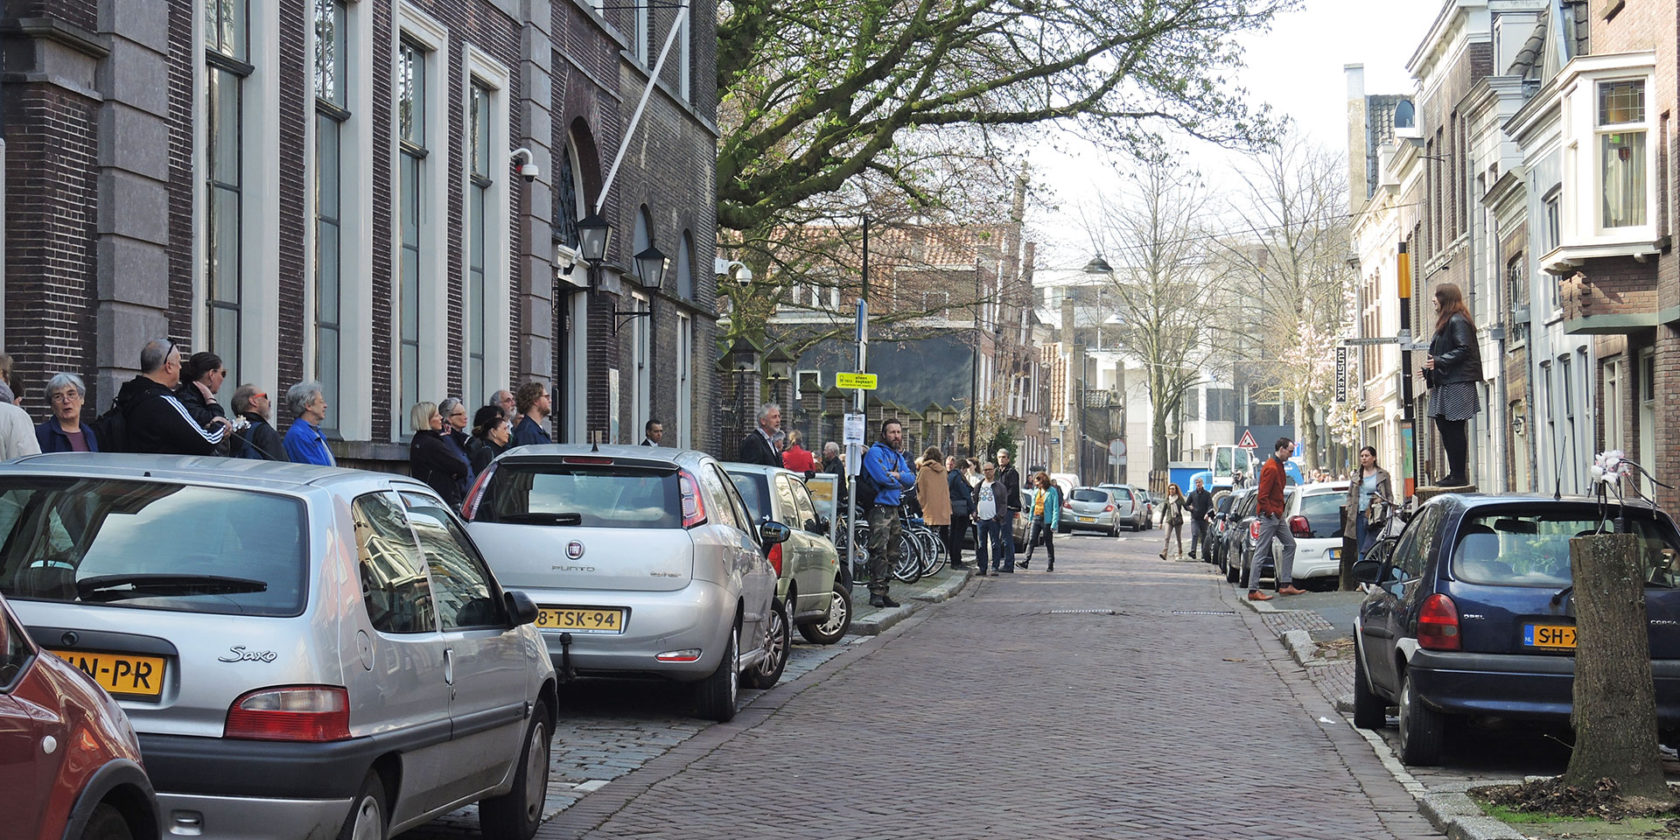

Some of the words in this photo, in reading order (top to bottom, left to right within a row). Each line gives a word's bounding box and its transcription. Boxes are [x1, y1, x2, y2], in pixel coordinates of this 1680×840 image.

[1337, 349, 1345, 400] KUNSTKERK
[218, 646, 278, 663] Saxo
[69, 656, 152, 689] N-PR
